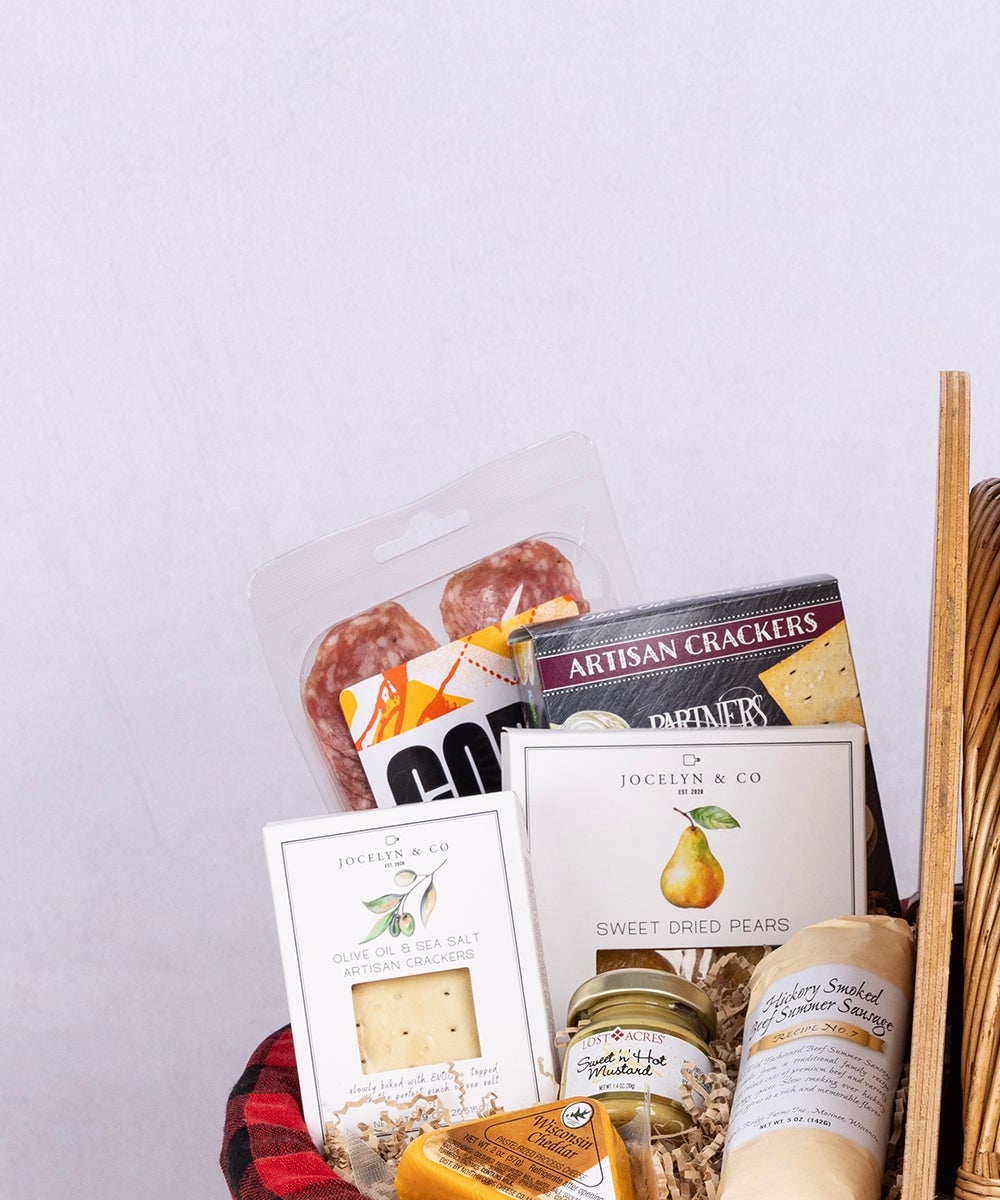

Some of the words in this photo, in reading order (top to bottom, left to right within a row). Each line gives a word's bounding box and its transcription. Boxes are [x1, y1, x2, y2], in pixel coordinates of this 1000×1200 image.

[569, 639, 678, 679] ARTISAN
[684, 612, 819, 656] CRACKERS
[648, 688, 768, 728] PARTNERS
[387, 701, 527, 805] CO
[620, 773, 703, 788] JOCELYN
[714, 773, 727, 784] &
[736, 772, 762, 784] CO
[338, 849, 404, 869] JOCELYN
[412, 848, 421, 856] &
[429, 843, 449, 854] CO
[596, 921, 660, 936] SWEET
[669, 919, 721, 935] DRIED
[730, 918, 790, 932] PEARS
[332, 949, 369, 964] OLIVE
[375, 946, 396, 957] OIL
[401, 943, 410, 953] &
[416, 939, 442, 951] SEA
[447, 933, 480, 947] SALT
[343, 961, 401, 978] ARTISAN
[406, 950, 475, 968] CRACKERS
[763, 983, 821, 1013] Hickory
[823, 978, 883, 1005] Smoked
[749, 1009, 778, 1041] Beef
[776, 1000, 836, 1023] Summer
[838, 998, 894, 1036] Sausage
[582, 1033, 610, 1050] LOST
[624, 1032, 664, 1044] ACRES
[772, 1023, 819, 1043] RECIPE
[577, 1052, 615, 1073] Sweet
[633, 1049, 667, 1067] Hot
[828, 1047, 863, 1061] Summer
[407, 1075, 426, 1085] with
[470, 1063, 498, 1079] topped
[588, 1065, 653, 1080] Mustard
[828, 1066, 847, 1078] beef
[847, 1075, 864, 1084] and
[840, 1061, 868, 1077] family
[427, 1081, 450, 1096] pinch
[483, 1076, 499, 1087] salt
[805, 1075, 838, 1088] smoking
[841, 1083, 860, 1092] over
[817, 1087, 860, 1104] memorable
[533, 1114, 593, 1150] Wisconsin
[759, 1121, 771, 1129] NET
[807, 1117, 831, 1127] (142G)
[495, 1134, 535, 1159] PASTEURIZED
[533, 1153, 563, 1171] PROCESS
[563, 1166, 588, 1180] CHEESE
[527, 1132, 578, 1160] Cheddar
[464, 1134, 478, 1145] NET
[478, 1140, 490, 1151] WT.
[505, 1154, 525, 1167] (57g)
[529, 1164, 562, 1185] Refrigerate
[563, 1180, 580, 1194] after
[438, 1157, 454, 1167] DIST.
[452, 1163, 461, 1171] BY
[496, 1183, 516, 1196] CHEESE
